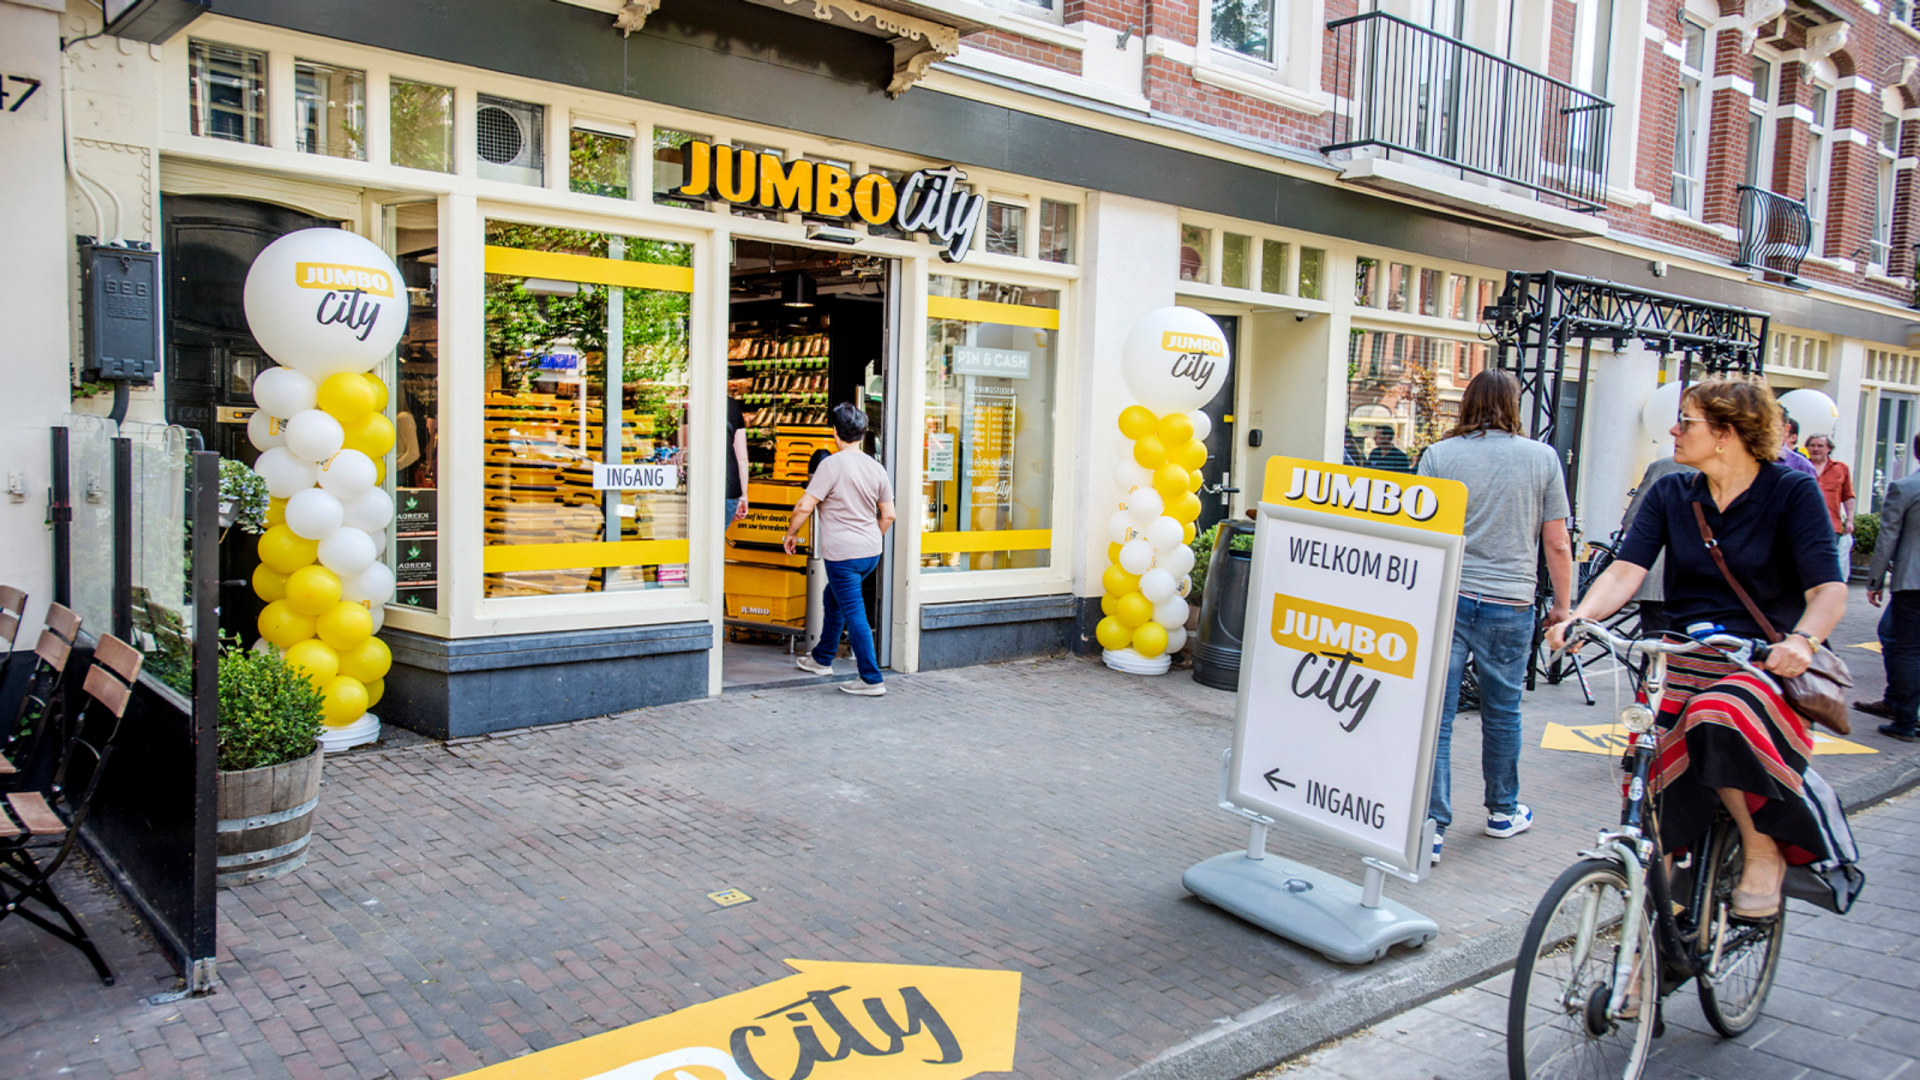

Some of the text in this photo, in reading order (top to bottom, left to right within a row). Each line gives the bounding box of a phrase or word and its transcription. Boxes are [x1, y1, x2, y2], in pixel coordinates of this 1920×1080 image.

[680, 140, 897, 226] JUMBO
[303, 267, 388, 291] JUMBO
[958, 351, 1027, 369] PIN & CASH
[1167, 335, 1220, 354] JUMBO
[607, 468, 664, 487] INGANG
[1284, 467, 1439, 522] JUMBO
[1290, 536, 1418, 591] WELKOM BIJ
[741, 605, 770, 616] JUMBO
[1278, 609, 1408, 662] JUMBO
[1306, 779, 1385, 830] INGANG
